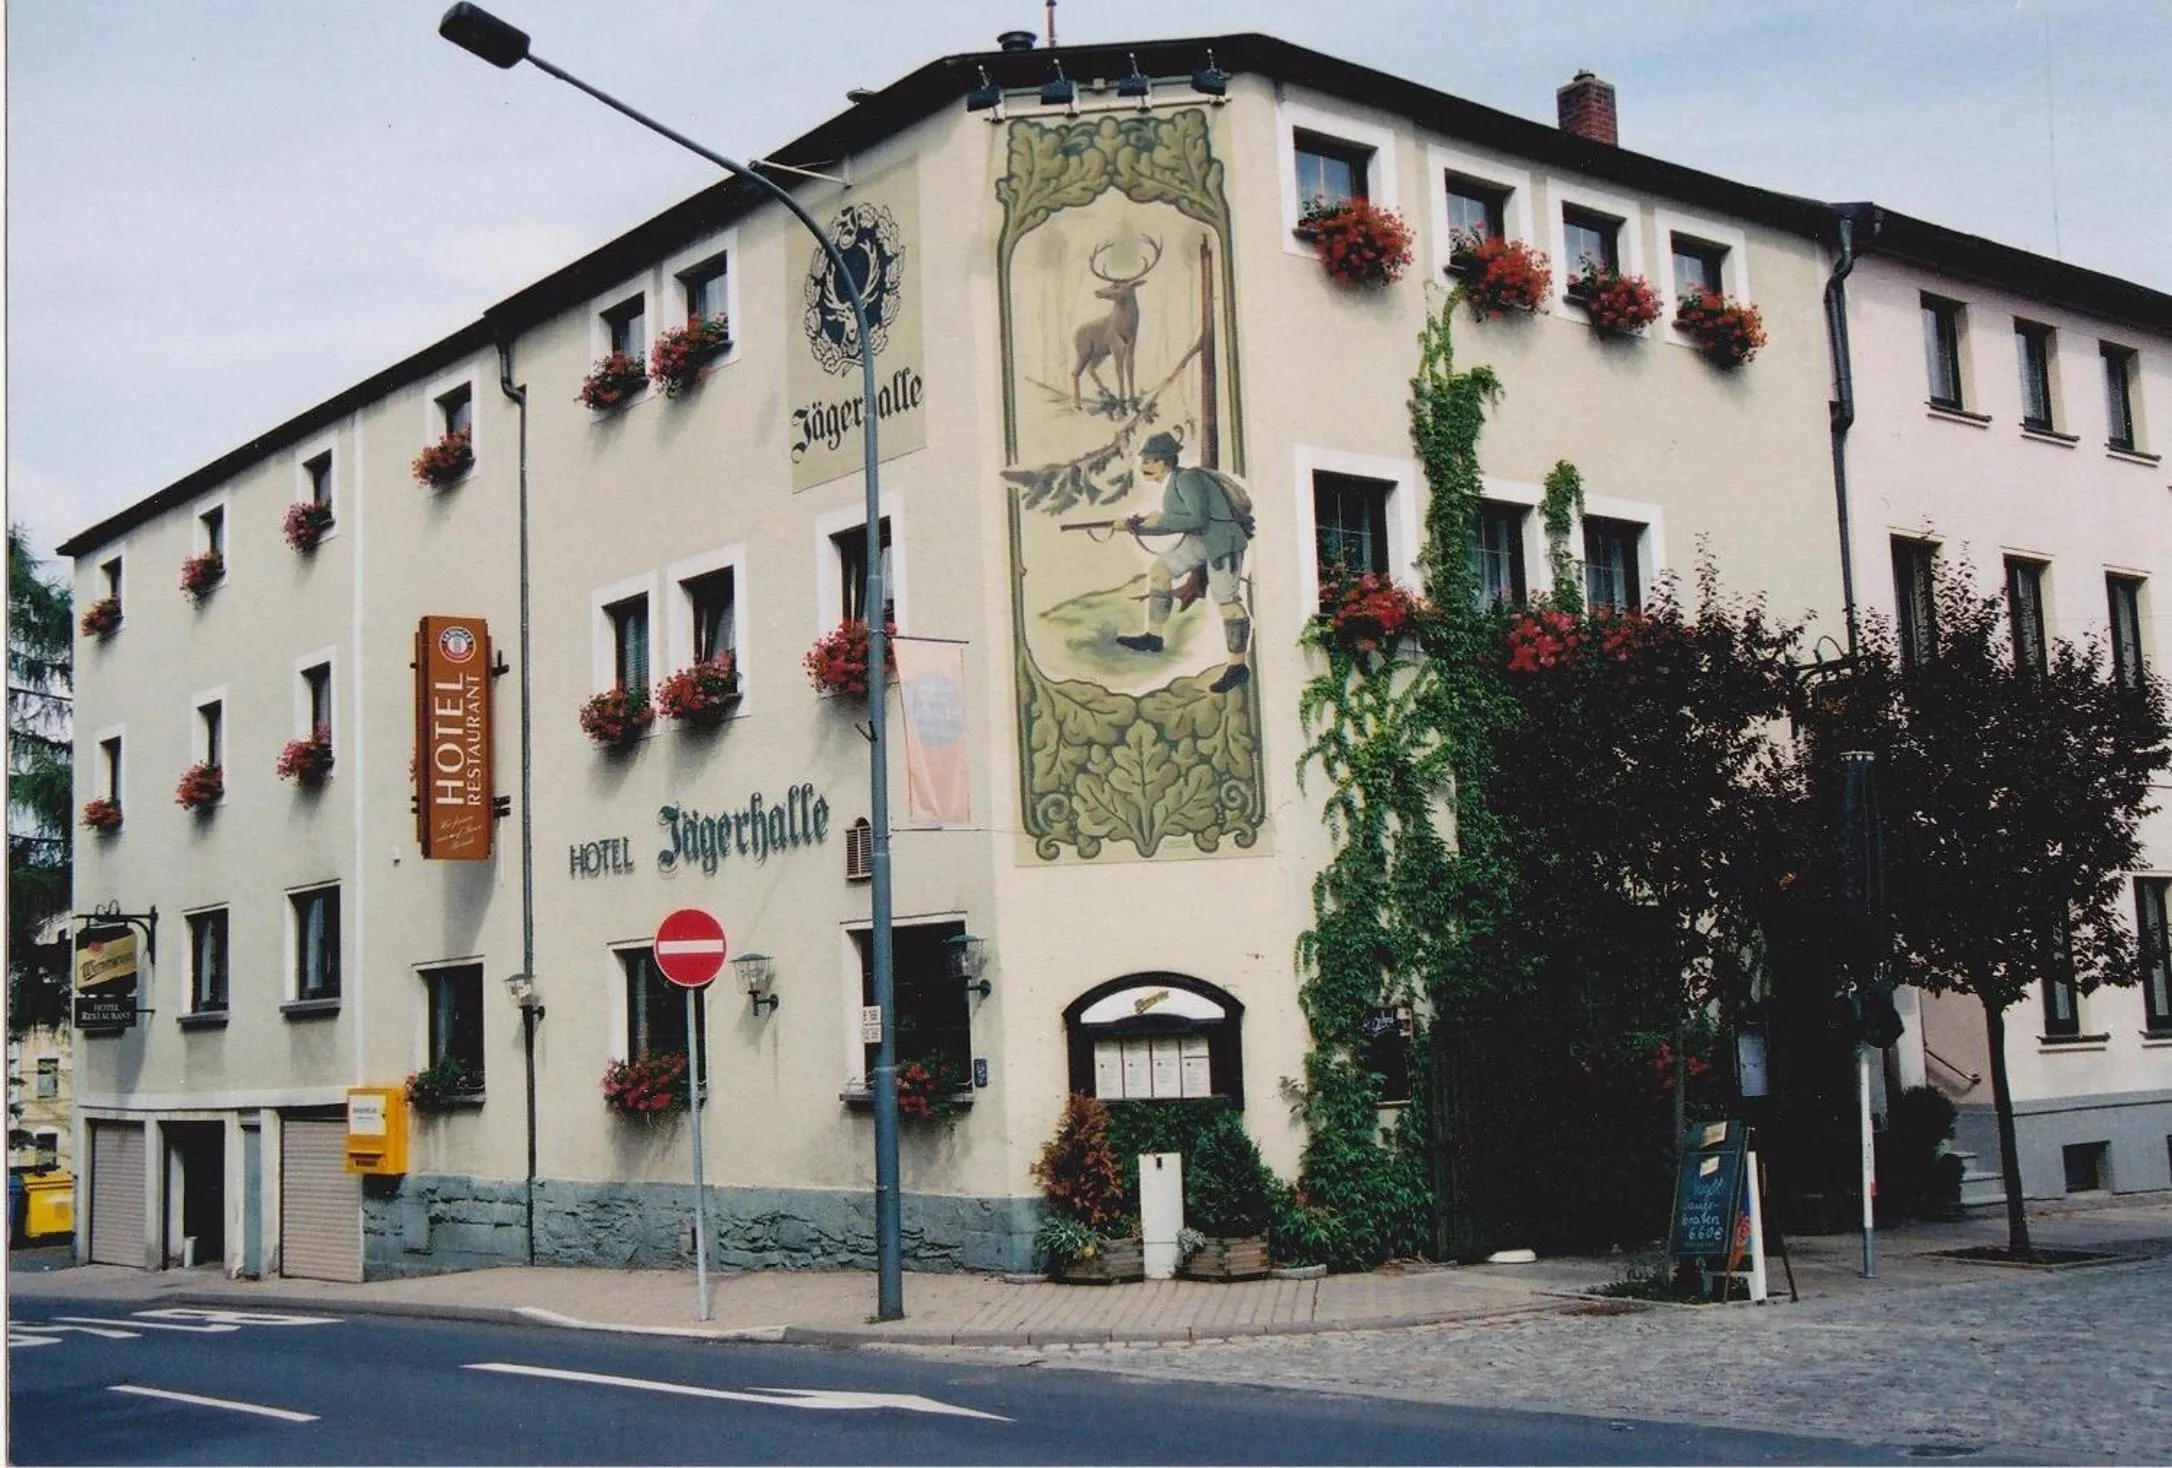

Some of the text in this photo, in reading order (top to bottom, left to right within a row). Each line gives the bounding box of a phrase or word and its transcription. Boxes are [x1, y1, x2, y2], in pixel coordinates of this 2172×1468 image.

[790, 367, 922, 464] Jägeralle
[436, 672, 464, 805] HOTEL
[467, 674, 482, 806] RESTAURANT
[570, 782, 830, 878] HOTEL Jägerhalle
